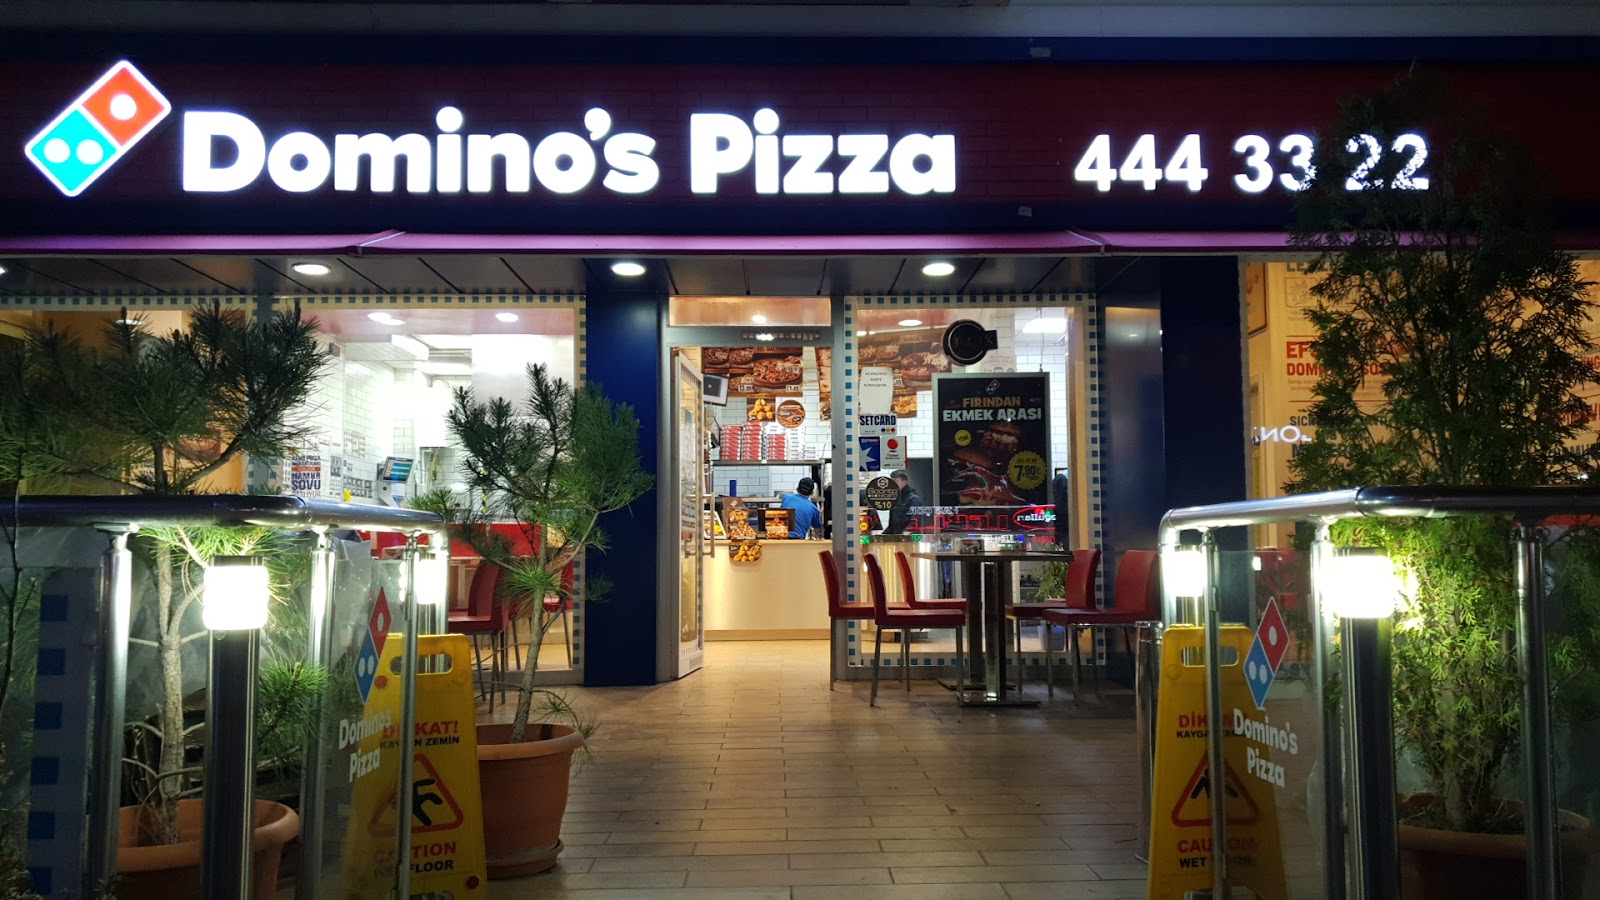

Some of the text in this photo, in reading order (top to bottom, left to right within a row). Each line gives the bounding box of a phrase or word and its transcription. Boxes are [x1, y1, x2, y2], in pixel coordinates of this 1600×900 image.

[183, 107, 955, 194] Domino's Pizza
[1075, 134, 1428, 192] 444 33 22
[962, 396, 1020, 408] FIRINDAN
[860, 415, 896, 426] SETCARD
[943, 408, 1042, 422] EKMEK ARASI
[874, 501, 892, 509] %10
[1234, 708, 1298, 754] Domino's
[426, 735, 460, 746] ZEMİN
[349, 748, 380, 783] Pizza
[1247, 747, 1286, 788] Pizza
[1179, 857, 1207, 868] WET
